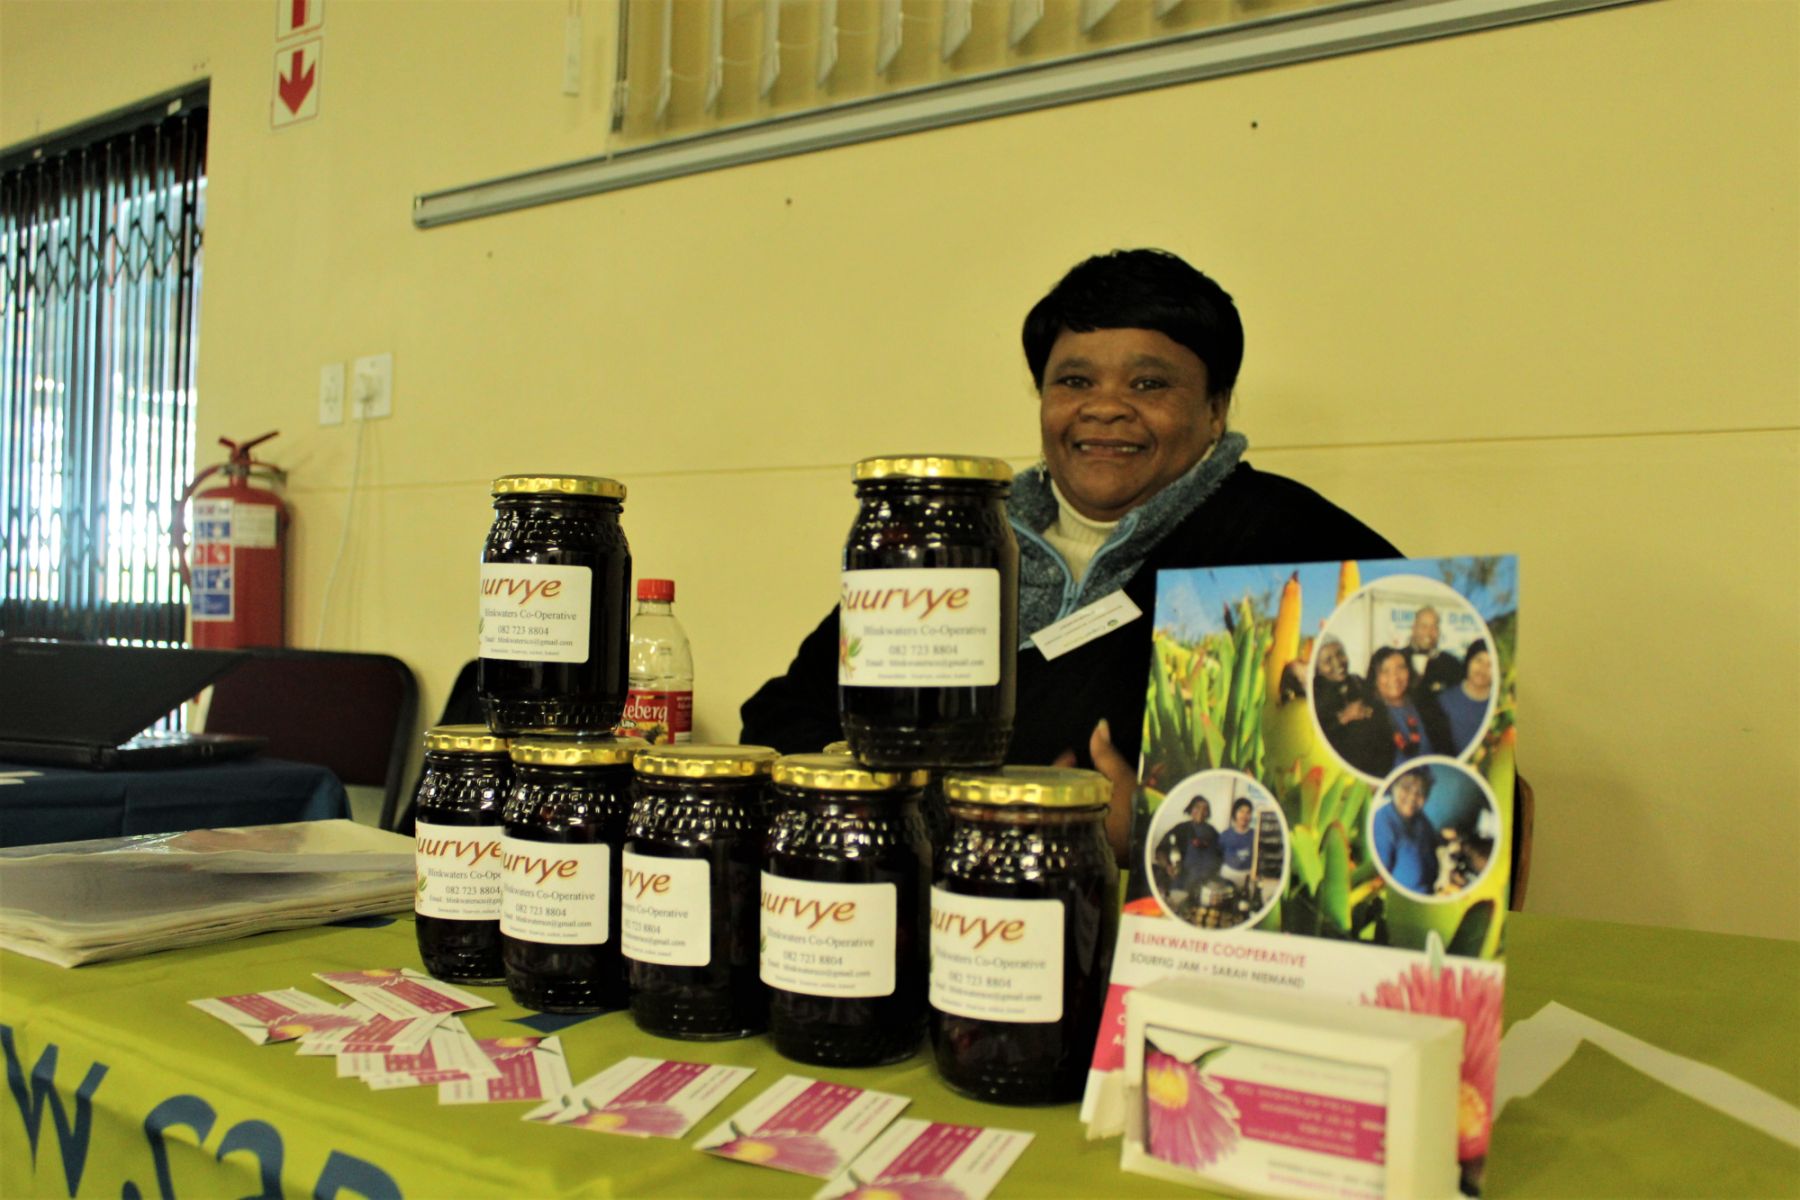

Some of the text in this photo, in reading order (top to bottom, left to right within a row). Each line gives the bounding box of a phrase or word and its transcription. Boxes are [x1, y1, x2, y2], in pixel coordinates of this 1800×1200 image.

[520, 609, 577, 622] Co-Operative
[497, 624, 550, 637] 082 723 8804
[920, 625, 987, 638] Co-Operative
[933, 644, 958, 656] 8804
[462, 886, 478, 896] 723
[536, 889, 595, 903] Co-Operative
[545, 906, 567, 918] 8804
[1133, 932, 1308, 969] BLINKWATER COOPERATIVE
[1177, 960, 1200, 972] JAM
